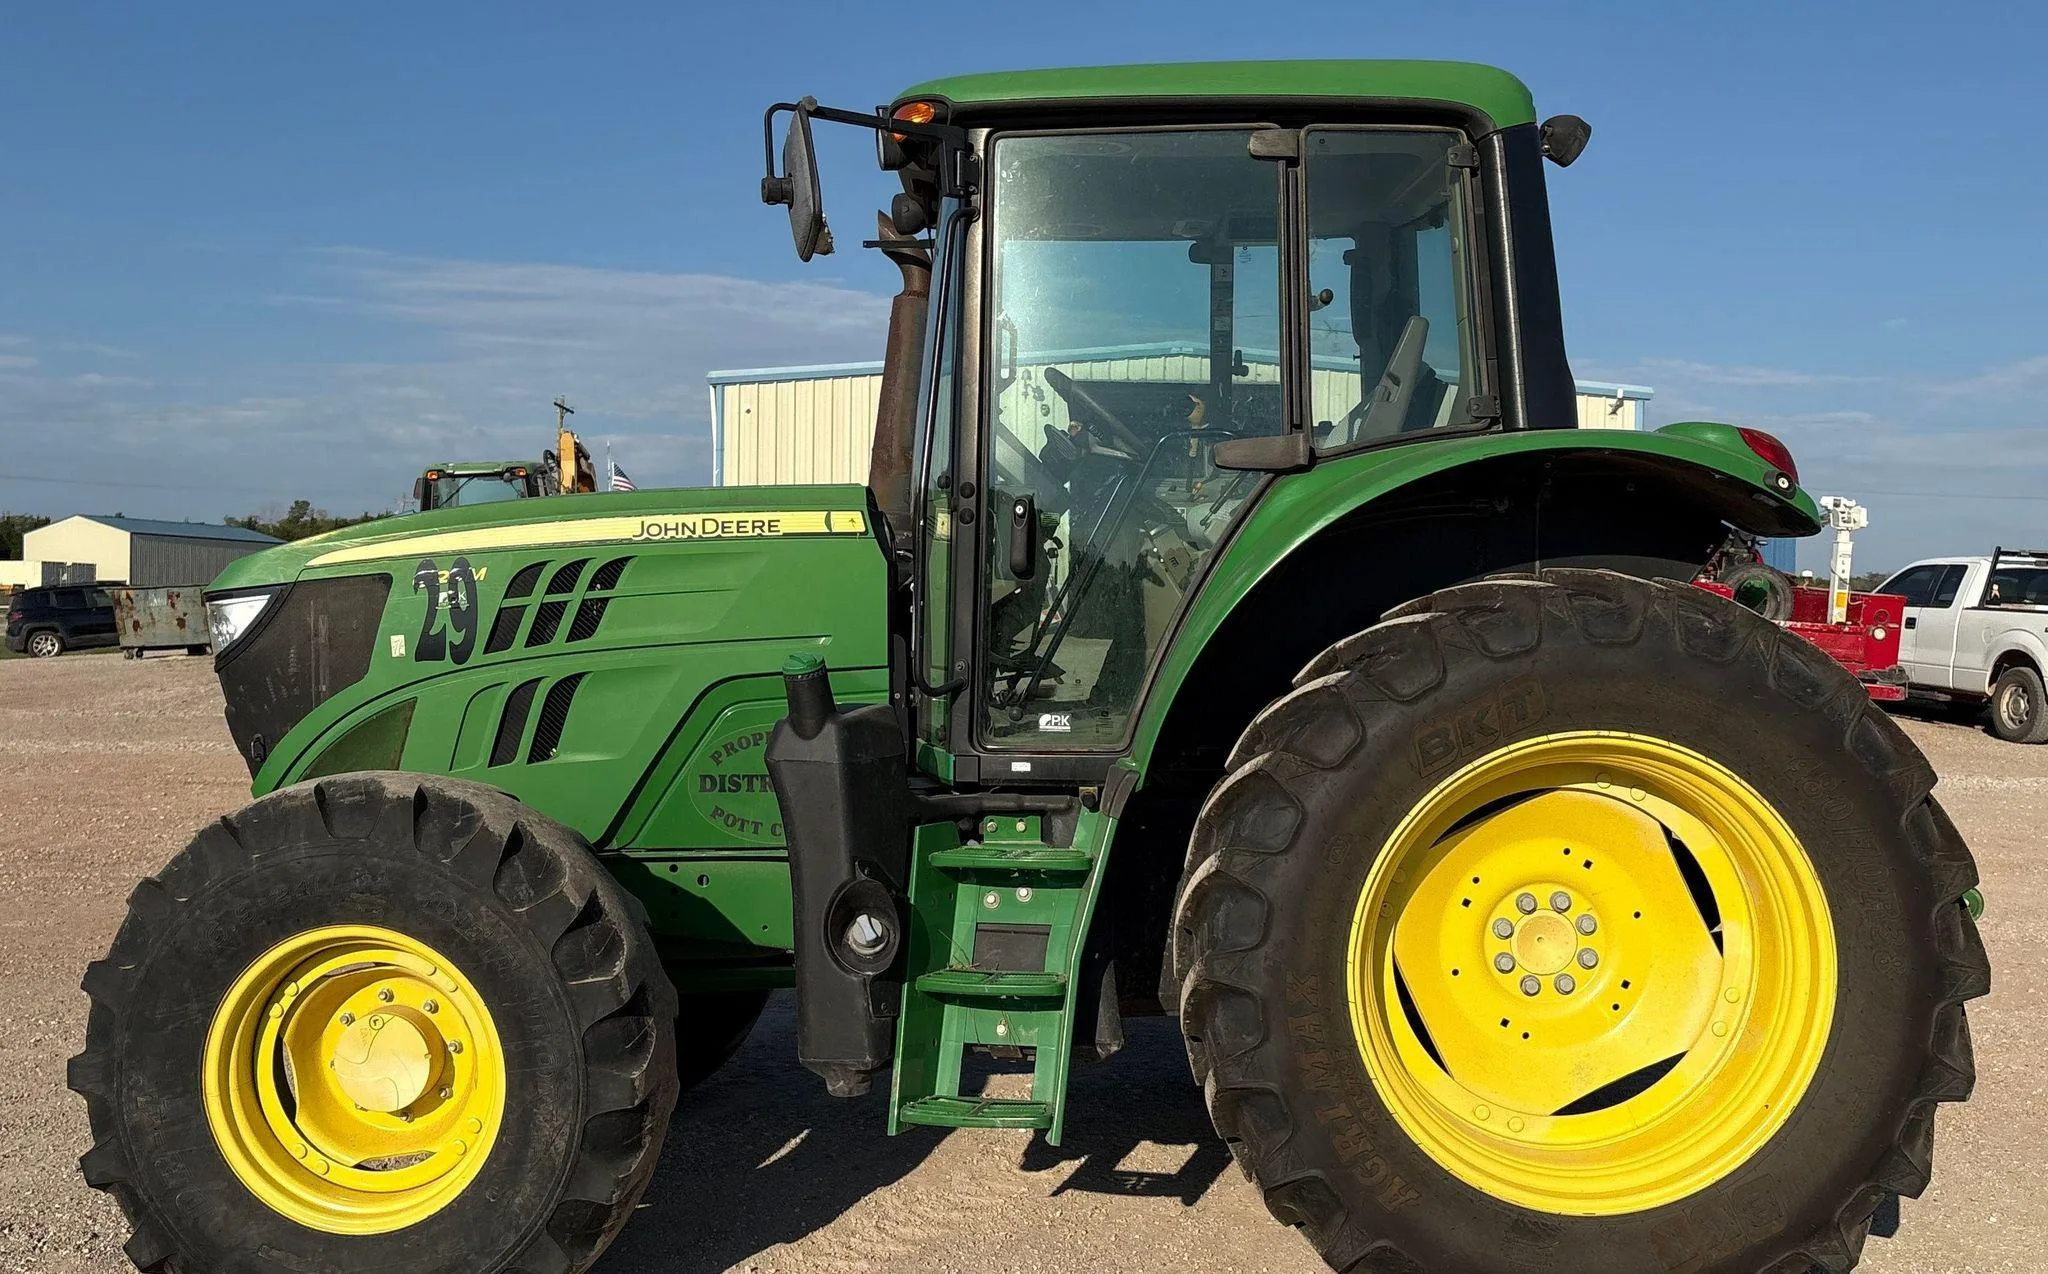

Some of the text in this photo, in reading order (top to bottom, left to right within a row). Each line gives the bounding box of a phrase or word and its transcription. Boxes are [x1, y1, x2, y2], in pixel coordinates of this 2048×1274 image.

[633, 518, 781, 538] JOHN DEERE
[412, 556, 479, 665] 29
[1412, 672, 1546, 778] BKT
[711, 805, 763, 835] POTT
[1285, 969, 1333, 1089] MAX
